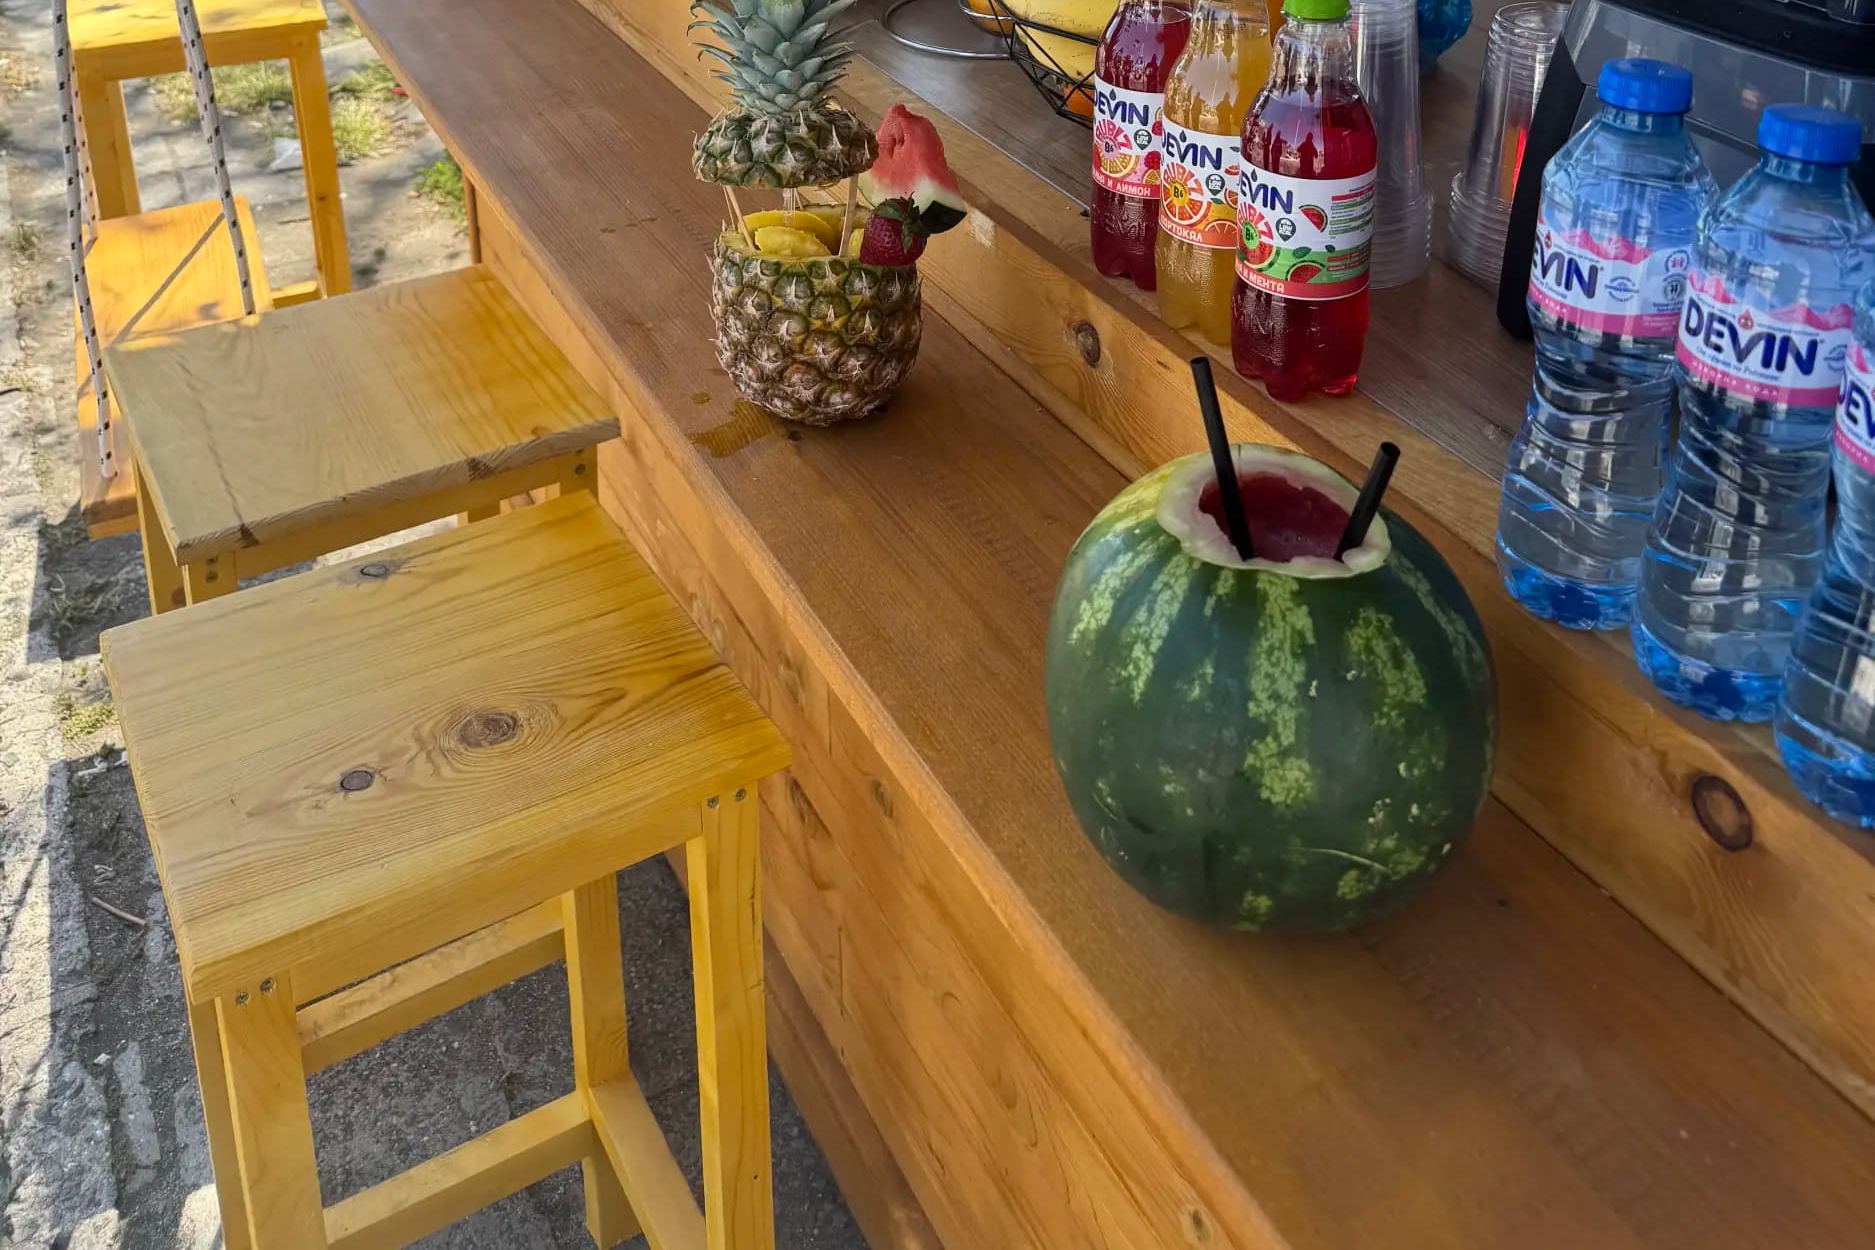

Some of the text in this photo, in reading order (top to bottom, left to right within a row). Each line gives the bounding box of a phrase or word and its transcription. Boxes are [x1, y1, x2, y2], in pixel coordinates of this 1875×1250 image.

[1116, 183, 1151, 196] ЛИМОН
[1238, 169, 1293, 214] EVIN
[1250, 272, 1284, 293] МЕНТА
[1532, 232, 1599, 299] EVIN
[1685, 298, 1819, 376] DEVIN
